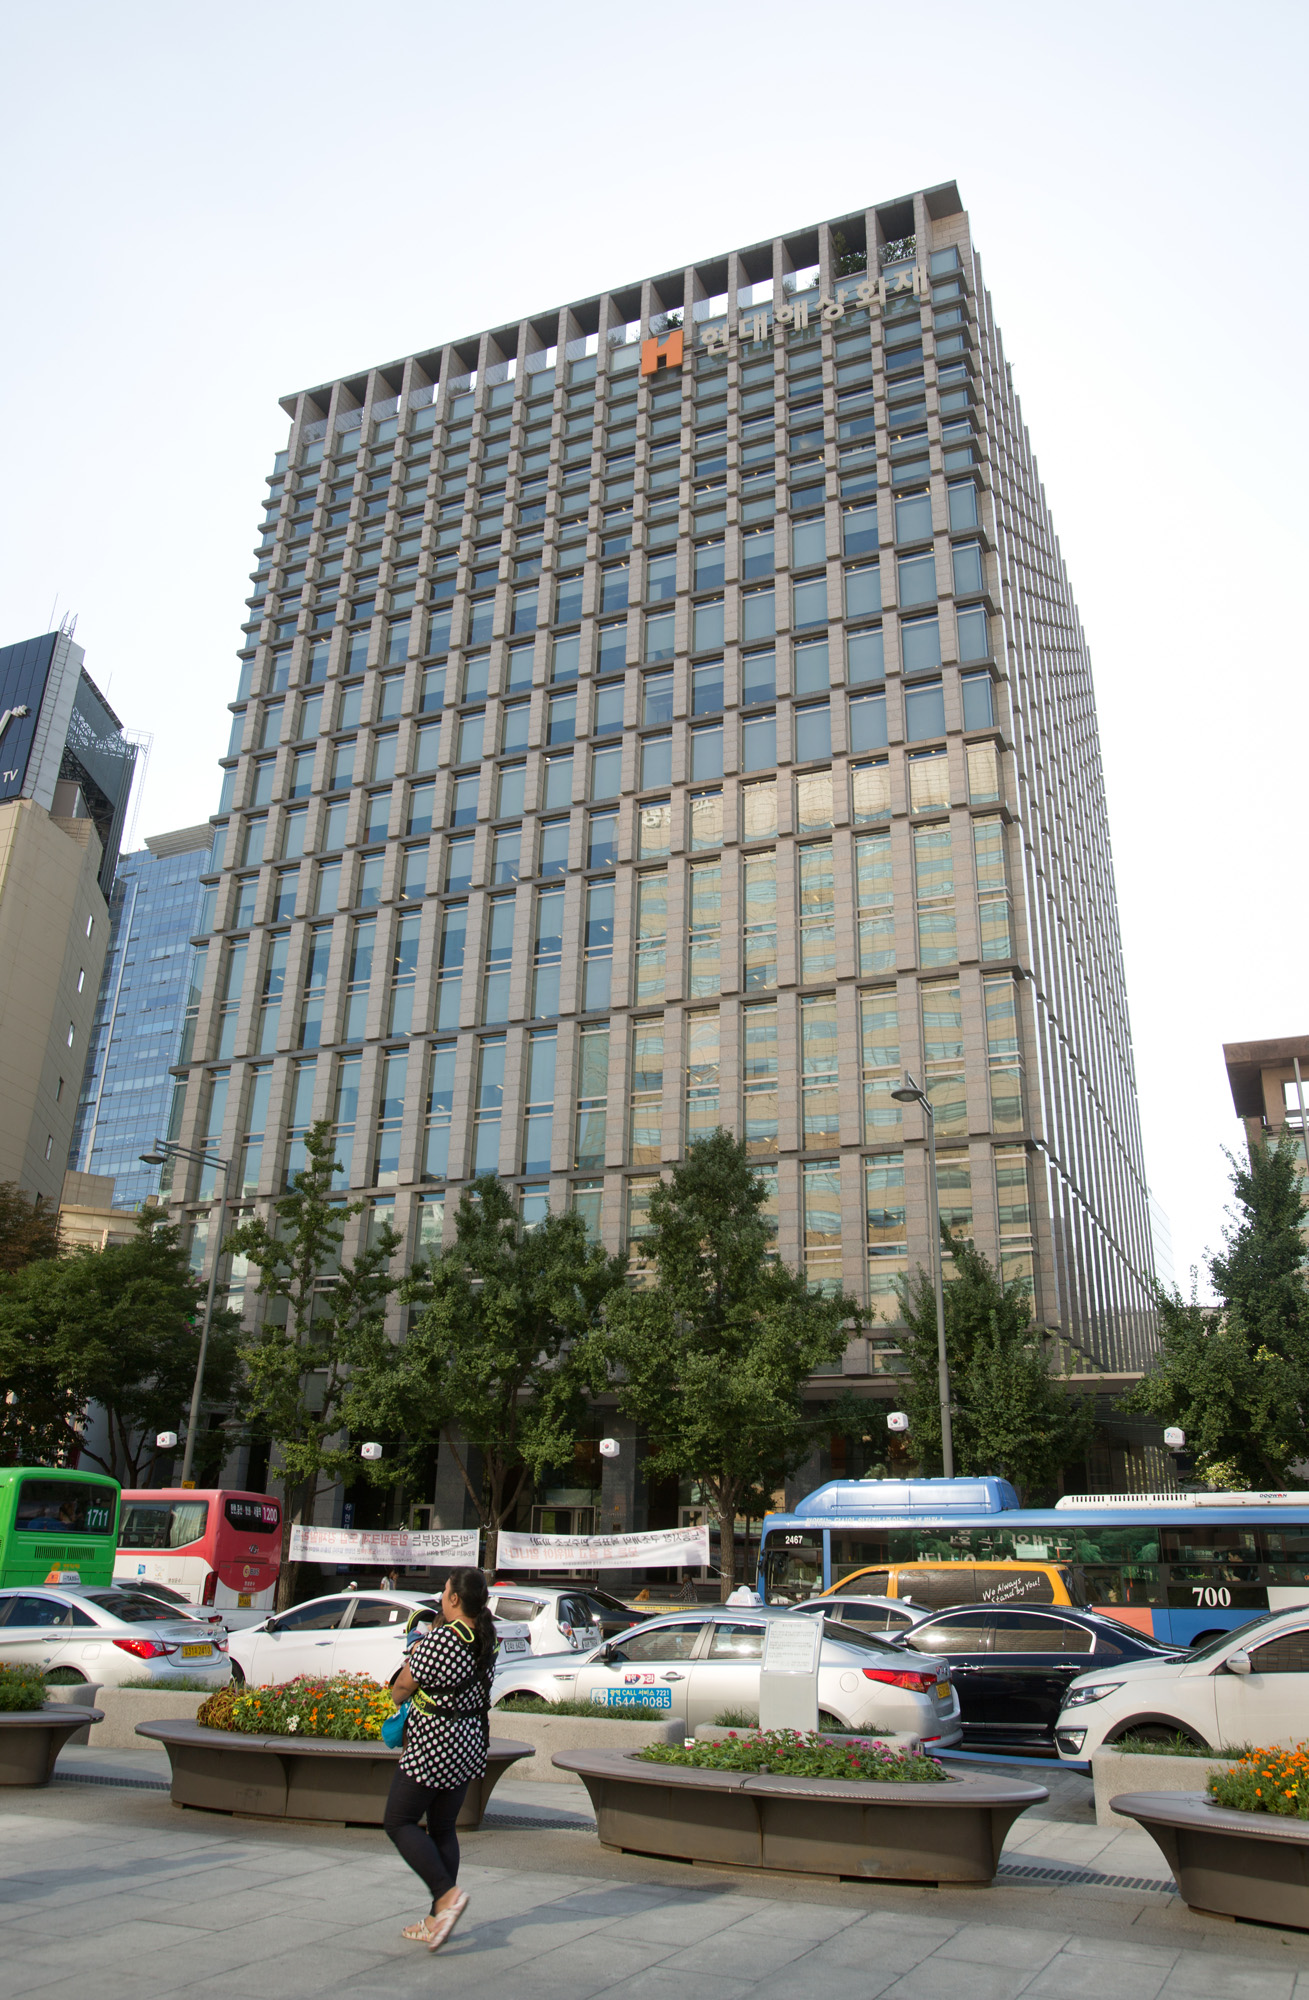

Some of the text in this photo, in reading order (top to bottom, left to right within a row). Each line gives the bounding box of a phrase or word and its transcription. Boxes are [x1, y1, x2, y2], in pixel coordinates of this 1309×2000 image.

[700, 265, 928, 357] 현대해상화재
[3, 769, 18, 783] TV
[86, 1506, 110, 1528] 1711
[262, 1507, 278, 1522] 1200
[785, 1535, 803, 1545] 2467
[982, 1577, 1022, 1601] We Always
[991, 1576, 1041, 1603] Stand by You!
[1192, 1586, 1231, 1607] 700
[609, 1696, 670, 1708] 1544-0085
[638, 1689, 655, 1697] 서비스
